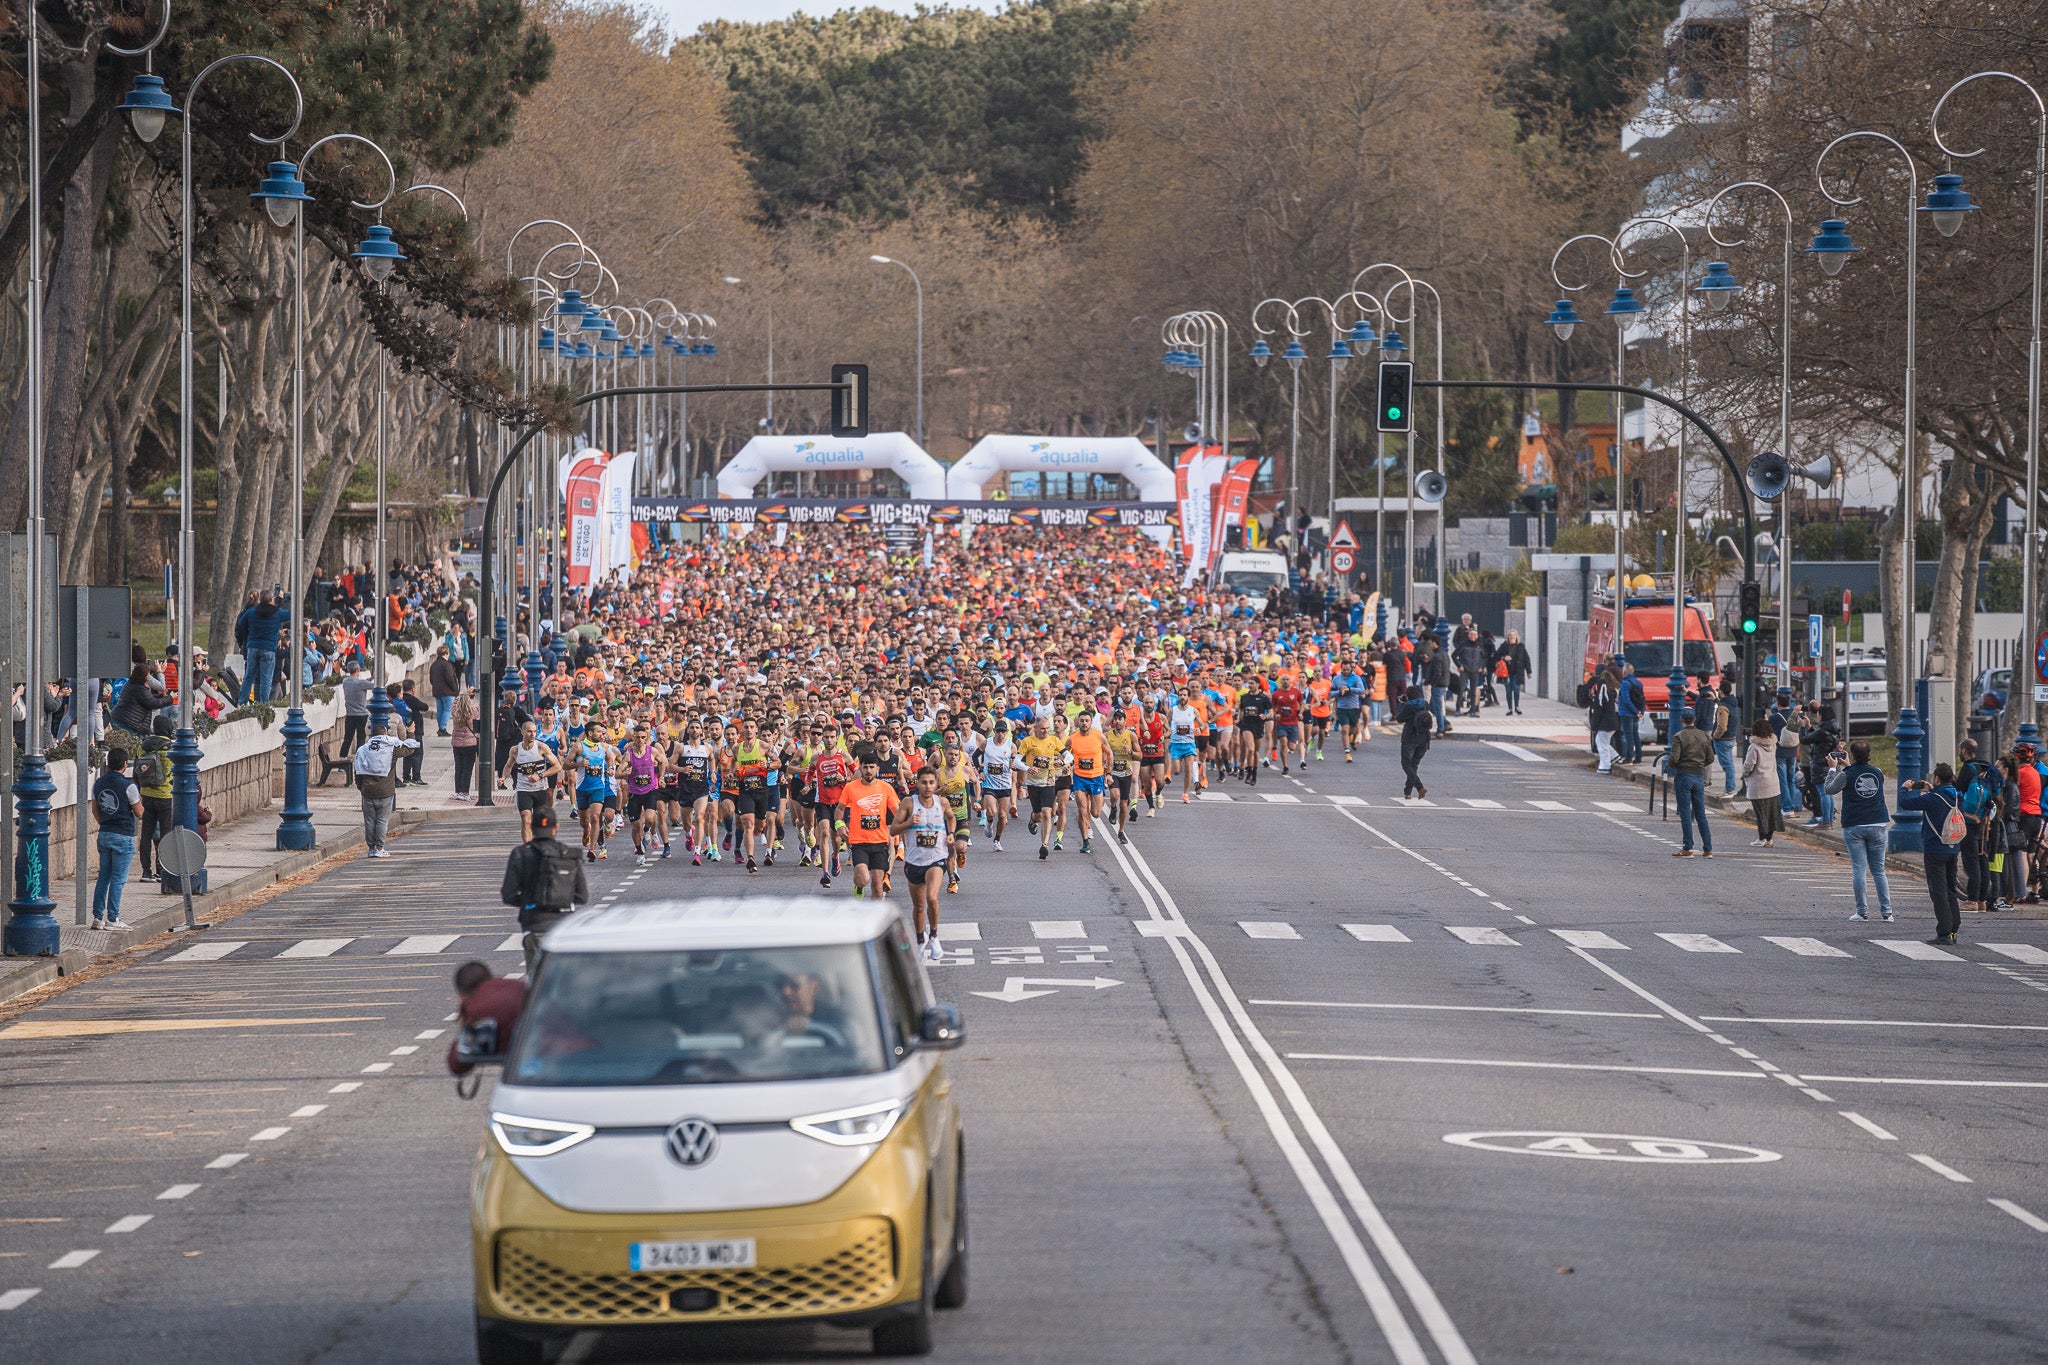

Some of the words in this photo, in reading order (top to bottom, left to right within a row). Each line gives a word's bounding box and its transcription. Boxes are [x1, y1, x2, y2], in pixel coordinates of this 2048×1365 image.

[805, 447, 865, 466] aqualia
[1039, 449, 1099, 467] aqualia
[612, 487, 623, 529] aqualia
[582, 544, 589, 558] DE
[1337, 557, 1351, 567] 30
[1811, 621, 1820, 653] P
[646, 1244, 702, 1267] 3403
